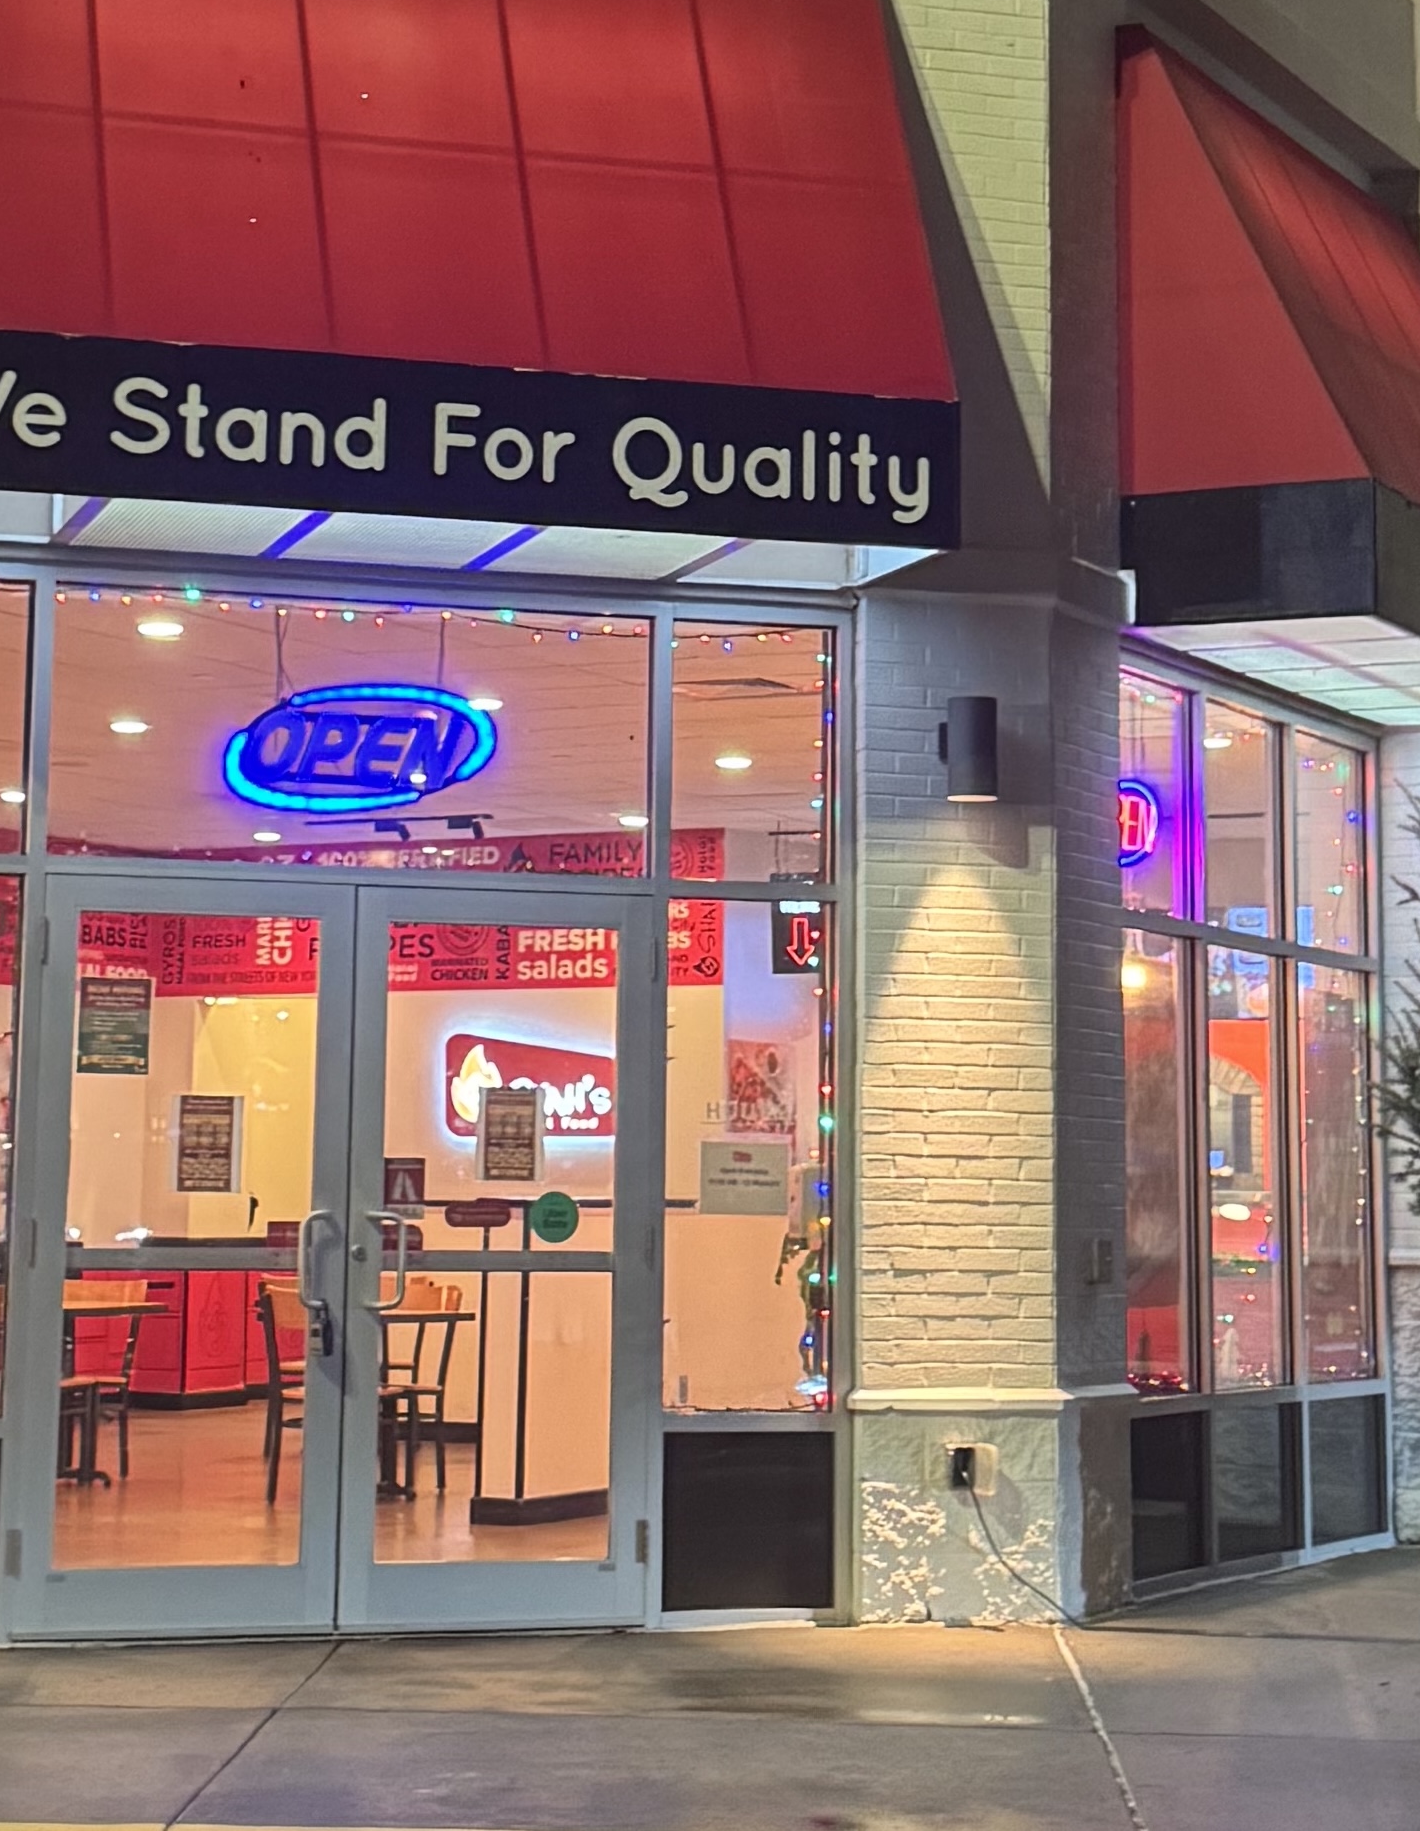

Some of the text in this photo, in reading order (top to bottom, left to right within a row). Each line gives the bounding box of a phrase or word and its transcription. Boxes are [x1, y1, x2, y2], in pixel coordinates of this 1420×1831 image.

[109, 376, 387, 472] Stand
[432, 402, 576, 483] For
[612, 415, 930, 524] Quality
[240, 708, 466, 789] OPEN
[549, 840, 642, 864] FAMILY
[81, 925, 127, 948] BABS
[192, 934, 247, 949] FRESH
[517, 929, 605, 952] FRESH
[431, 968, 489, 981] CHICKEN
[517, 953, 609, 980] salads
